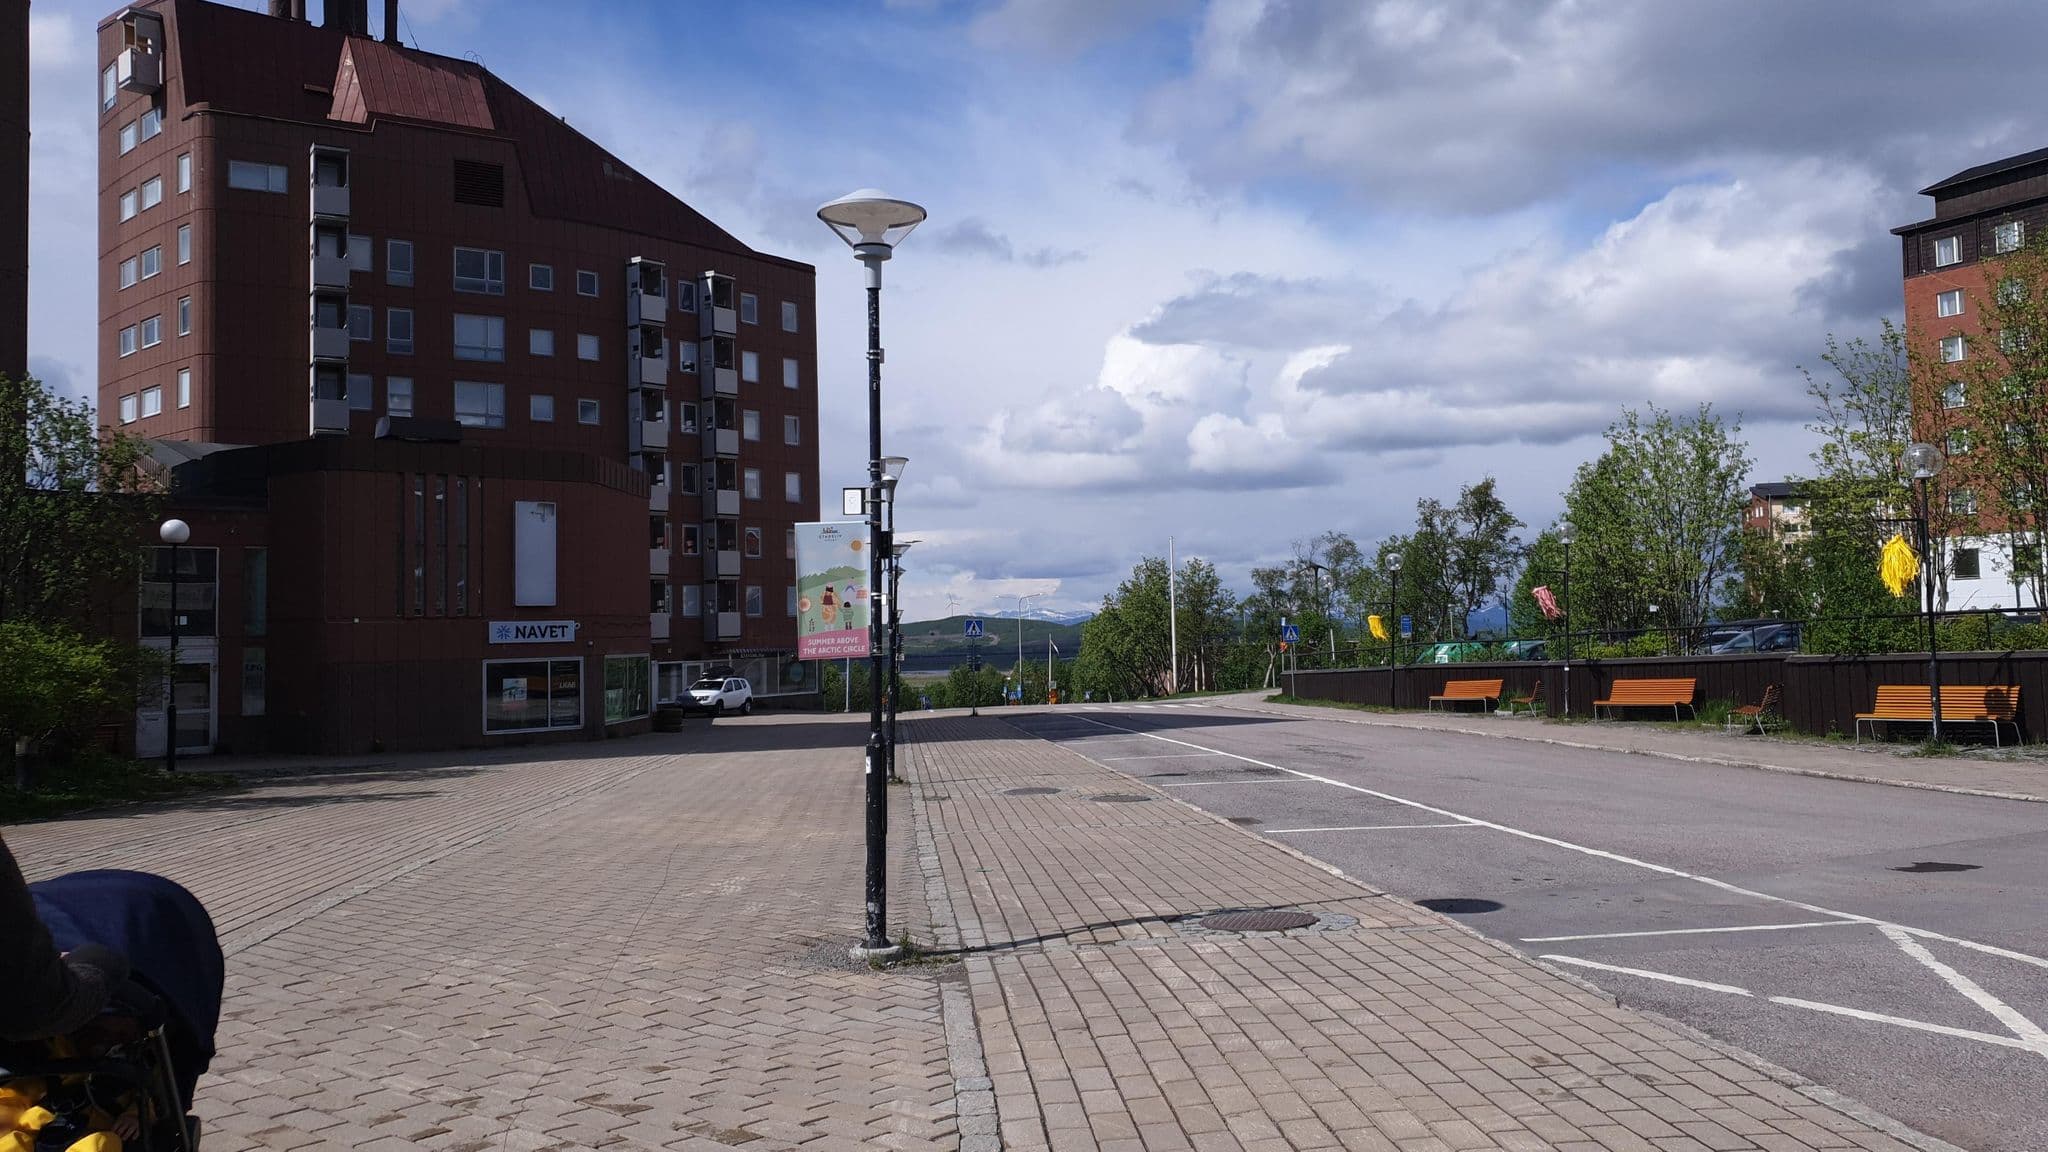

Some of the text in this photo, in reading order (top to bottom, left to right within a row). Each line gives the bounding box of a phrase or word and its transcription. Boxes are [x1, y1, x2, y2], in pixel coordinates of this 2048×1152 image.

[515, 626, 568, 638] NAVET
[808, 636, 859, 646] SUMMER ABOVE
[803, 645, 865, 655] THE ARCTIC CIRCLE
